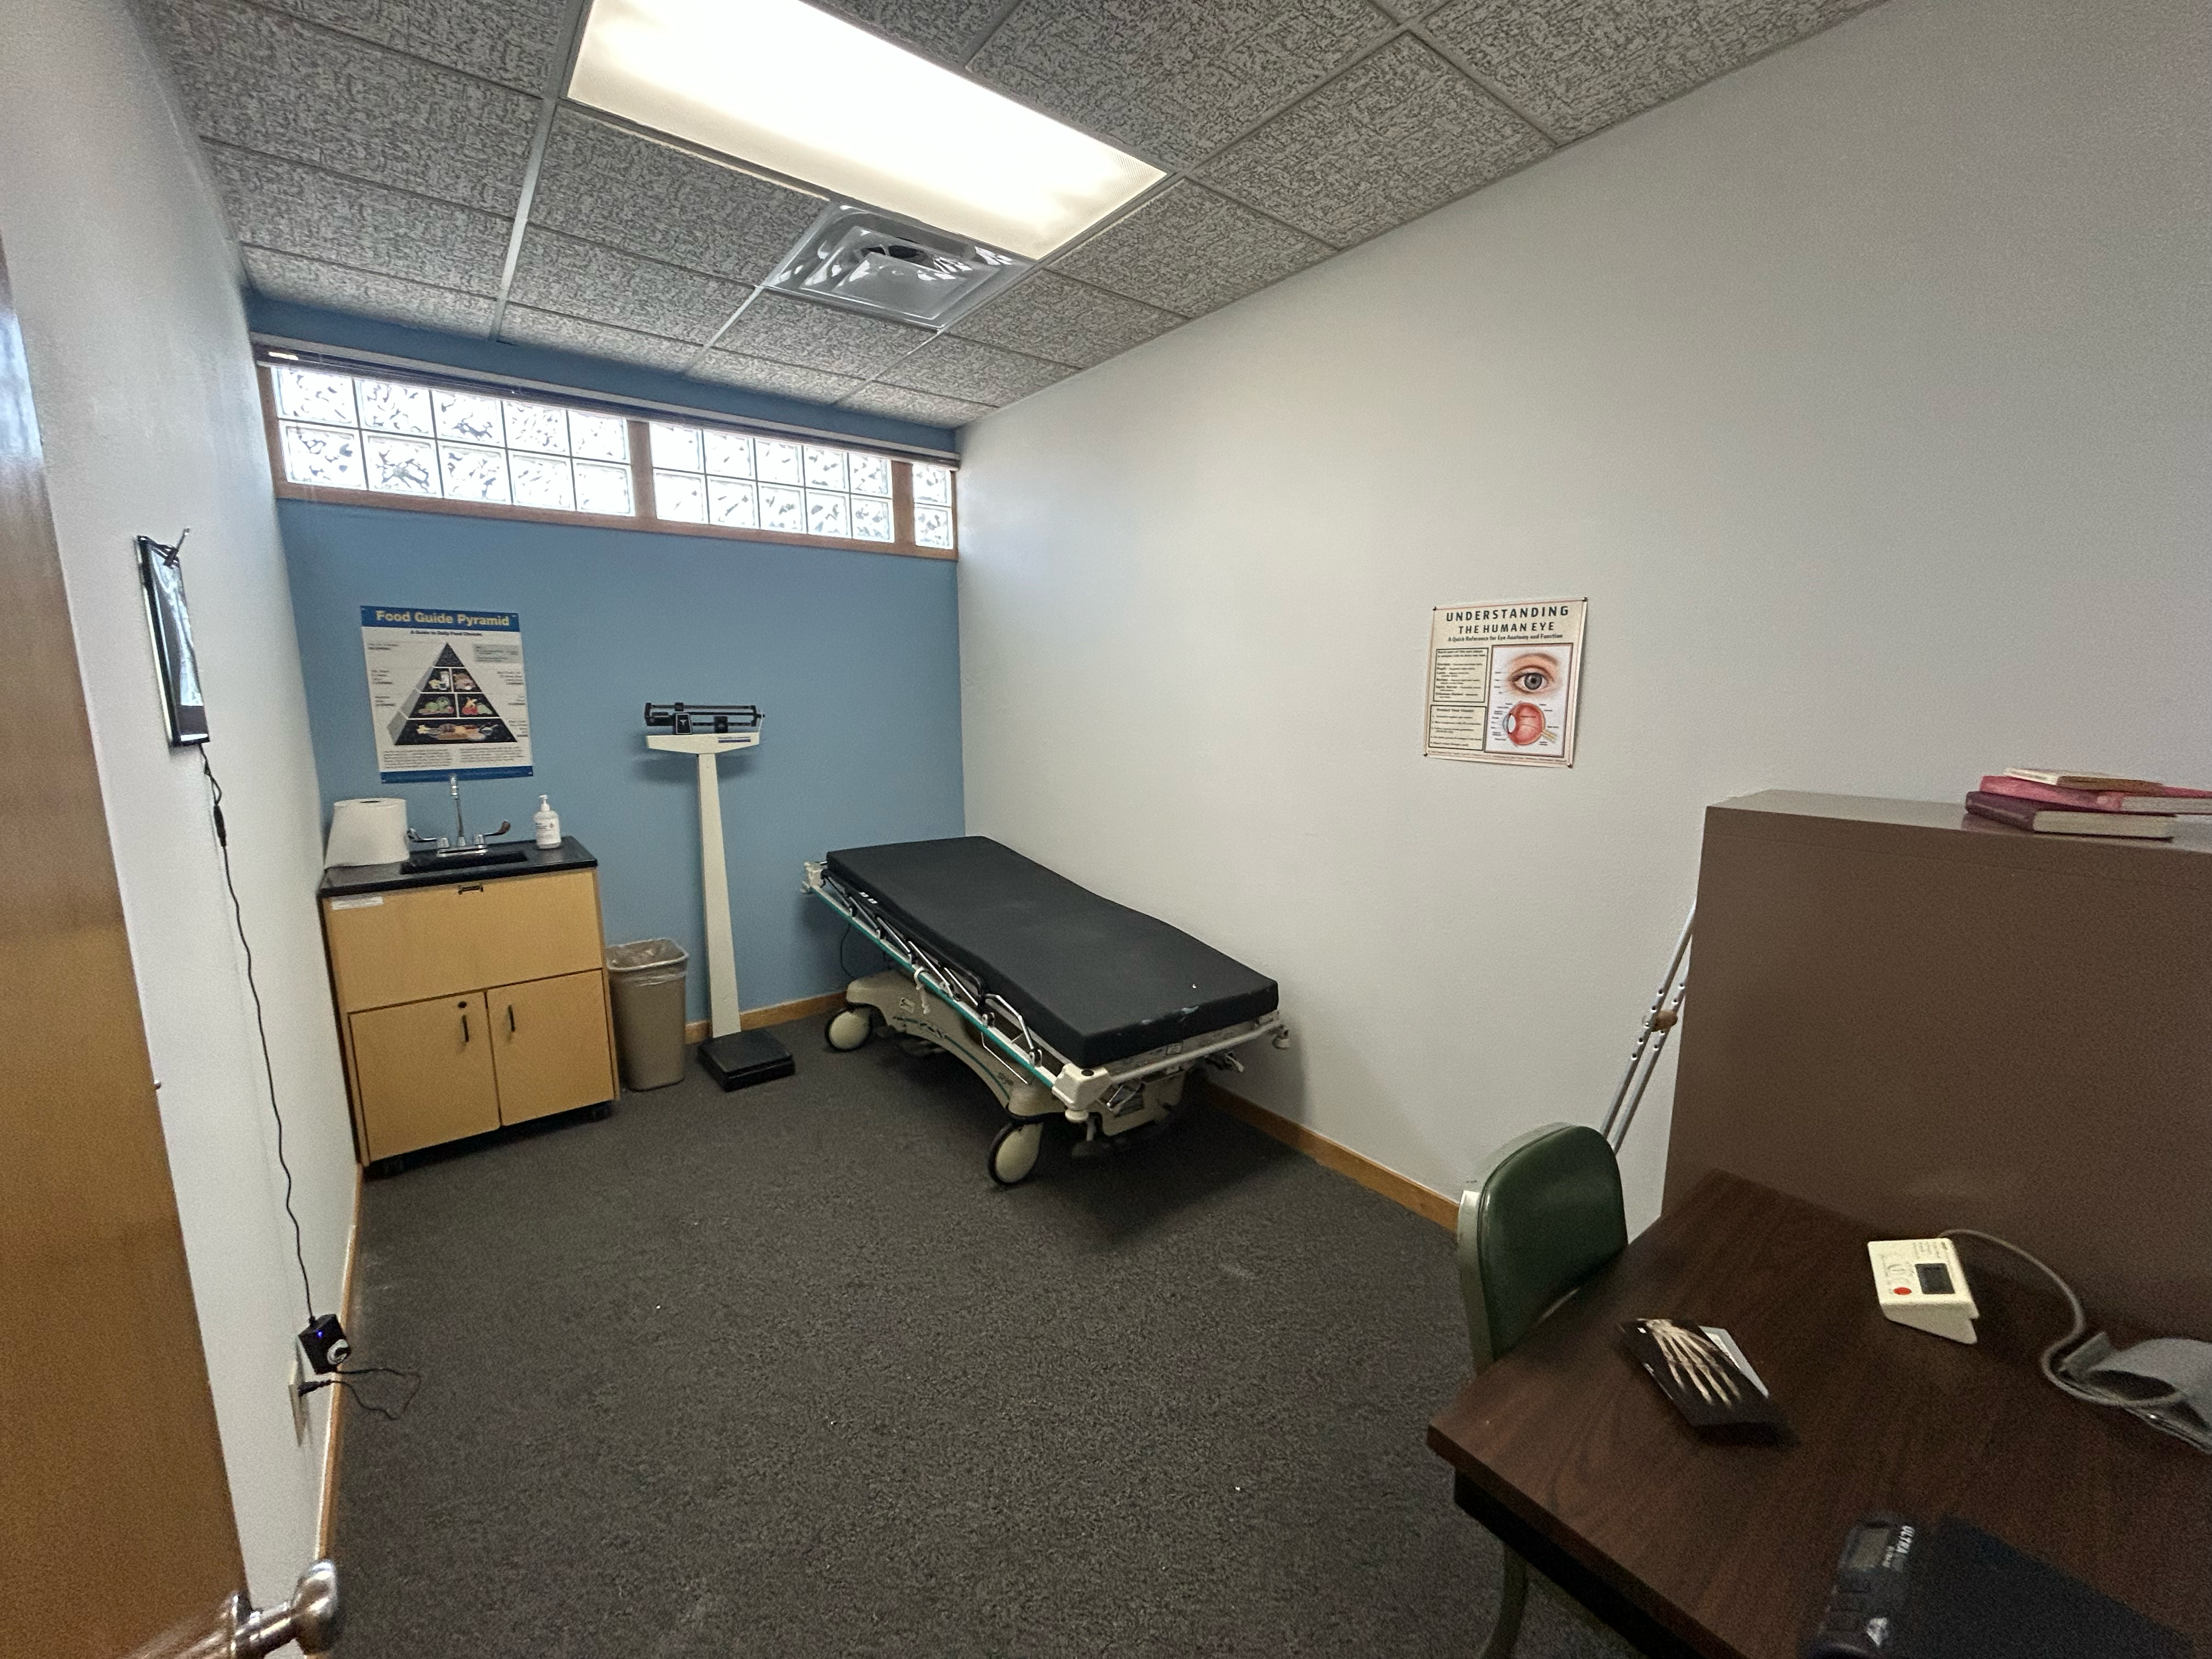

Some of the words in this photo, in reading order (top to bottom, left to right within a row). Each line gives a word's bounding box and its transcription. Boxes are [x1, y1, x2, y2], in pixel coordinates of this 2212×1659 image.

[375, 610, 411, 622] Food
[415, 611, 454, 624] Guide
[457, 613, 510, 626] Pyramid
[1446, 606, 1568, 621] UNDERSTANDING
[1459, 625, 1479, 634] THE
[1483, 623, 1527, 633] HUMAN
[1531, 622, 1555, 631] EYE
[1895, 1525, 1914, 1554] ULTRA
